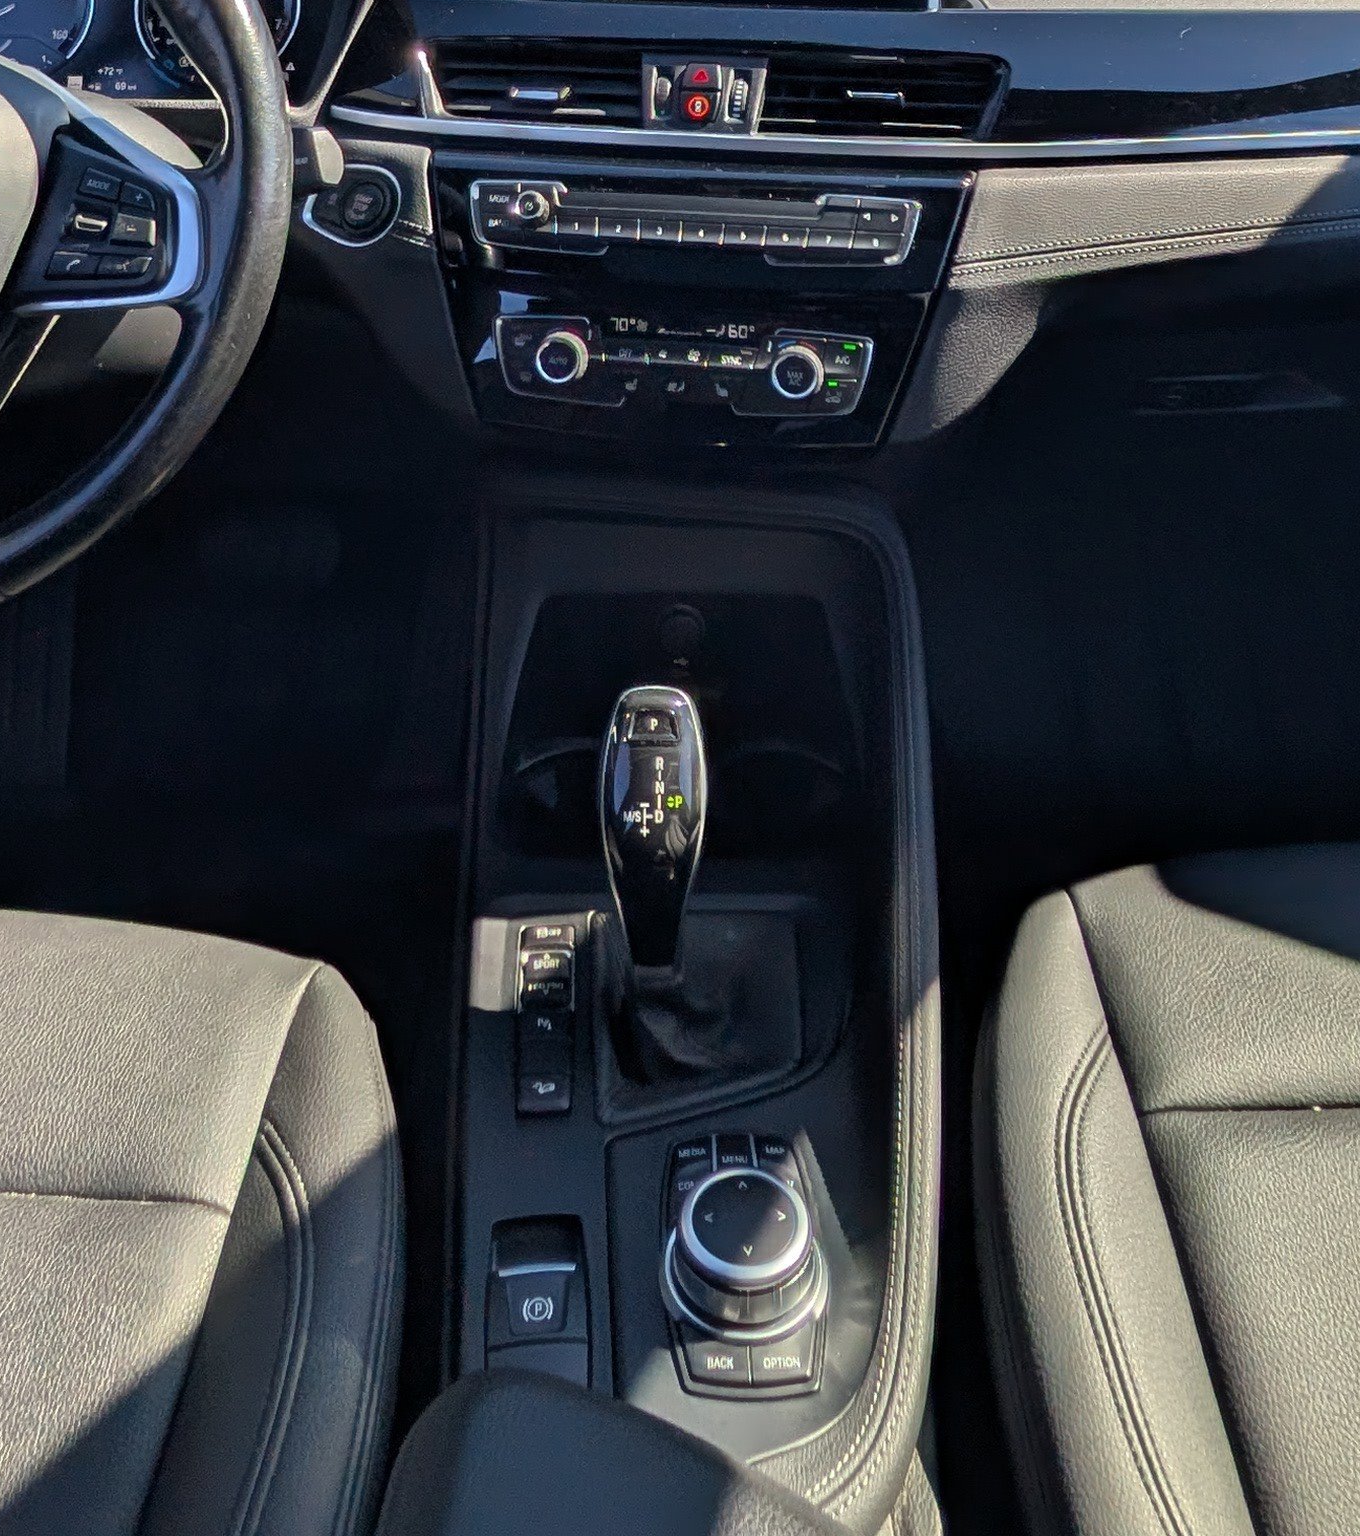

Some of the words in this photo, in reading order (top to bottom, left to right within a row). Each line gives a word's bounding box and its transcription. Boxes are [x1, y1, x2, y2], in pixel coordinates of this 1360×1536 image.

[114, 81, 128, 92] 69
[573, 221, 580, 232] 1
[615, 224, 622, 234] 2
[655, 226, 663, 237] 3
[697, 228, 705, 239] 4
[781, 232, 790, 243] 6
[824, 234, 832, 245] 7
[871, 237, 880, 248] 8
[720, 355, 743, 366] SYNC
[650, 717, 659, 731] P
[655, 756, 664, 770] R
[655, 780, 665, 794] N
[623, 810, 642, 823] M/S
[654, 811, 664, 824] D
[533, 958, 561, 970] SPORT
[678, 1147, 707, 1158] MEDIA
[764, 1145, 786, 1155] MAP
[721, 1155, 748, 1164] MENU
[706, 1354, 734, 1370] BACK
[762, 1354, 801, 1370] OPTION
